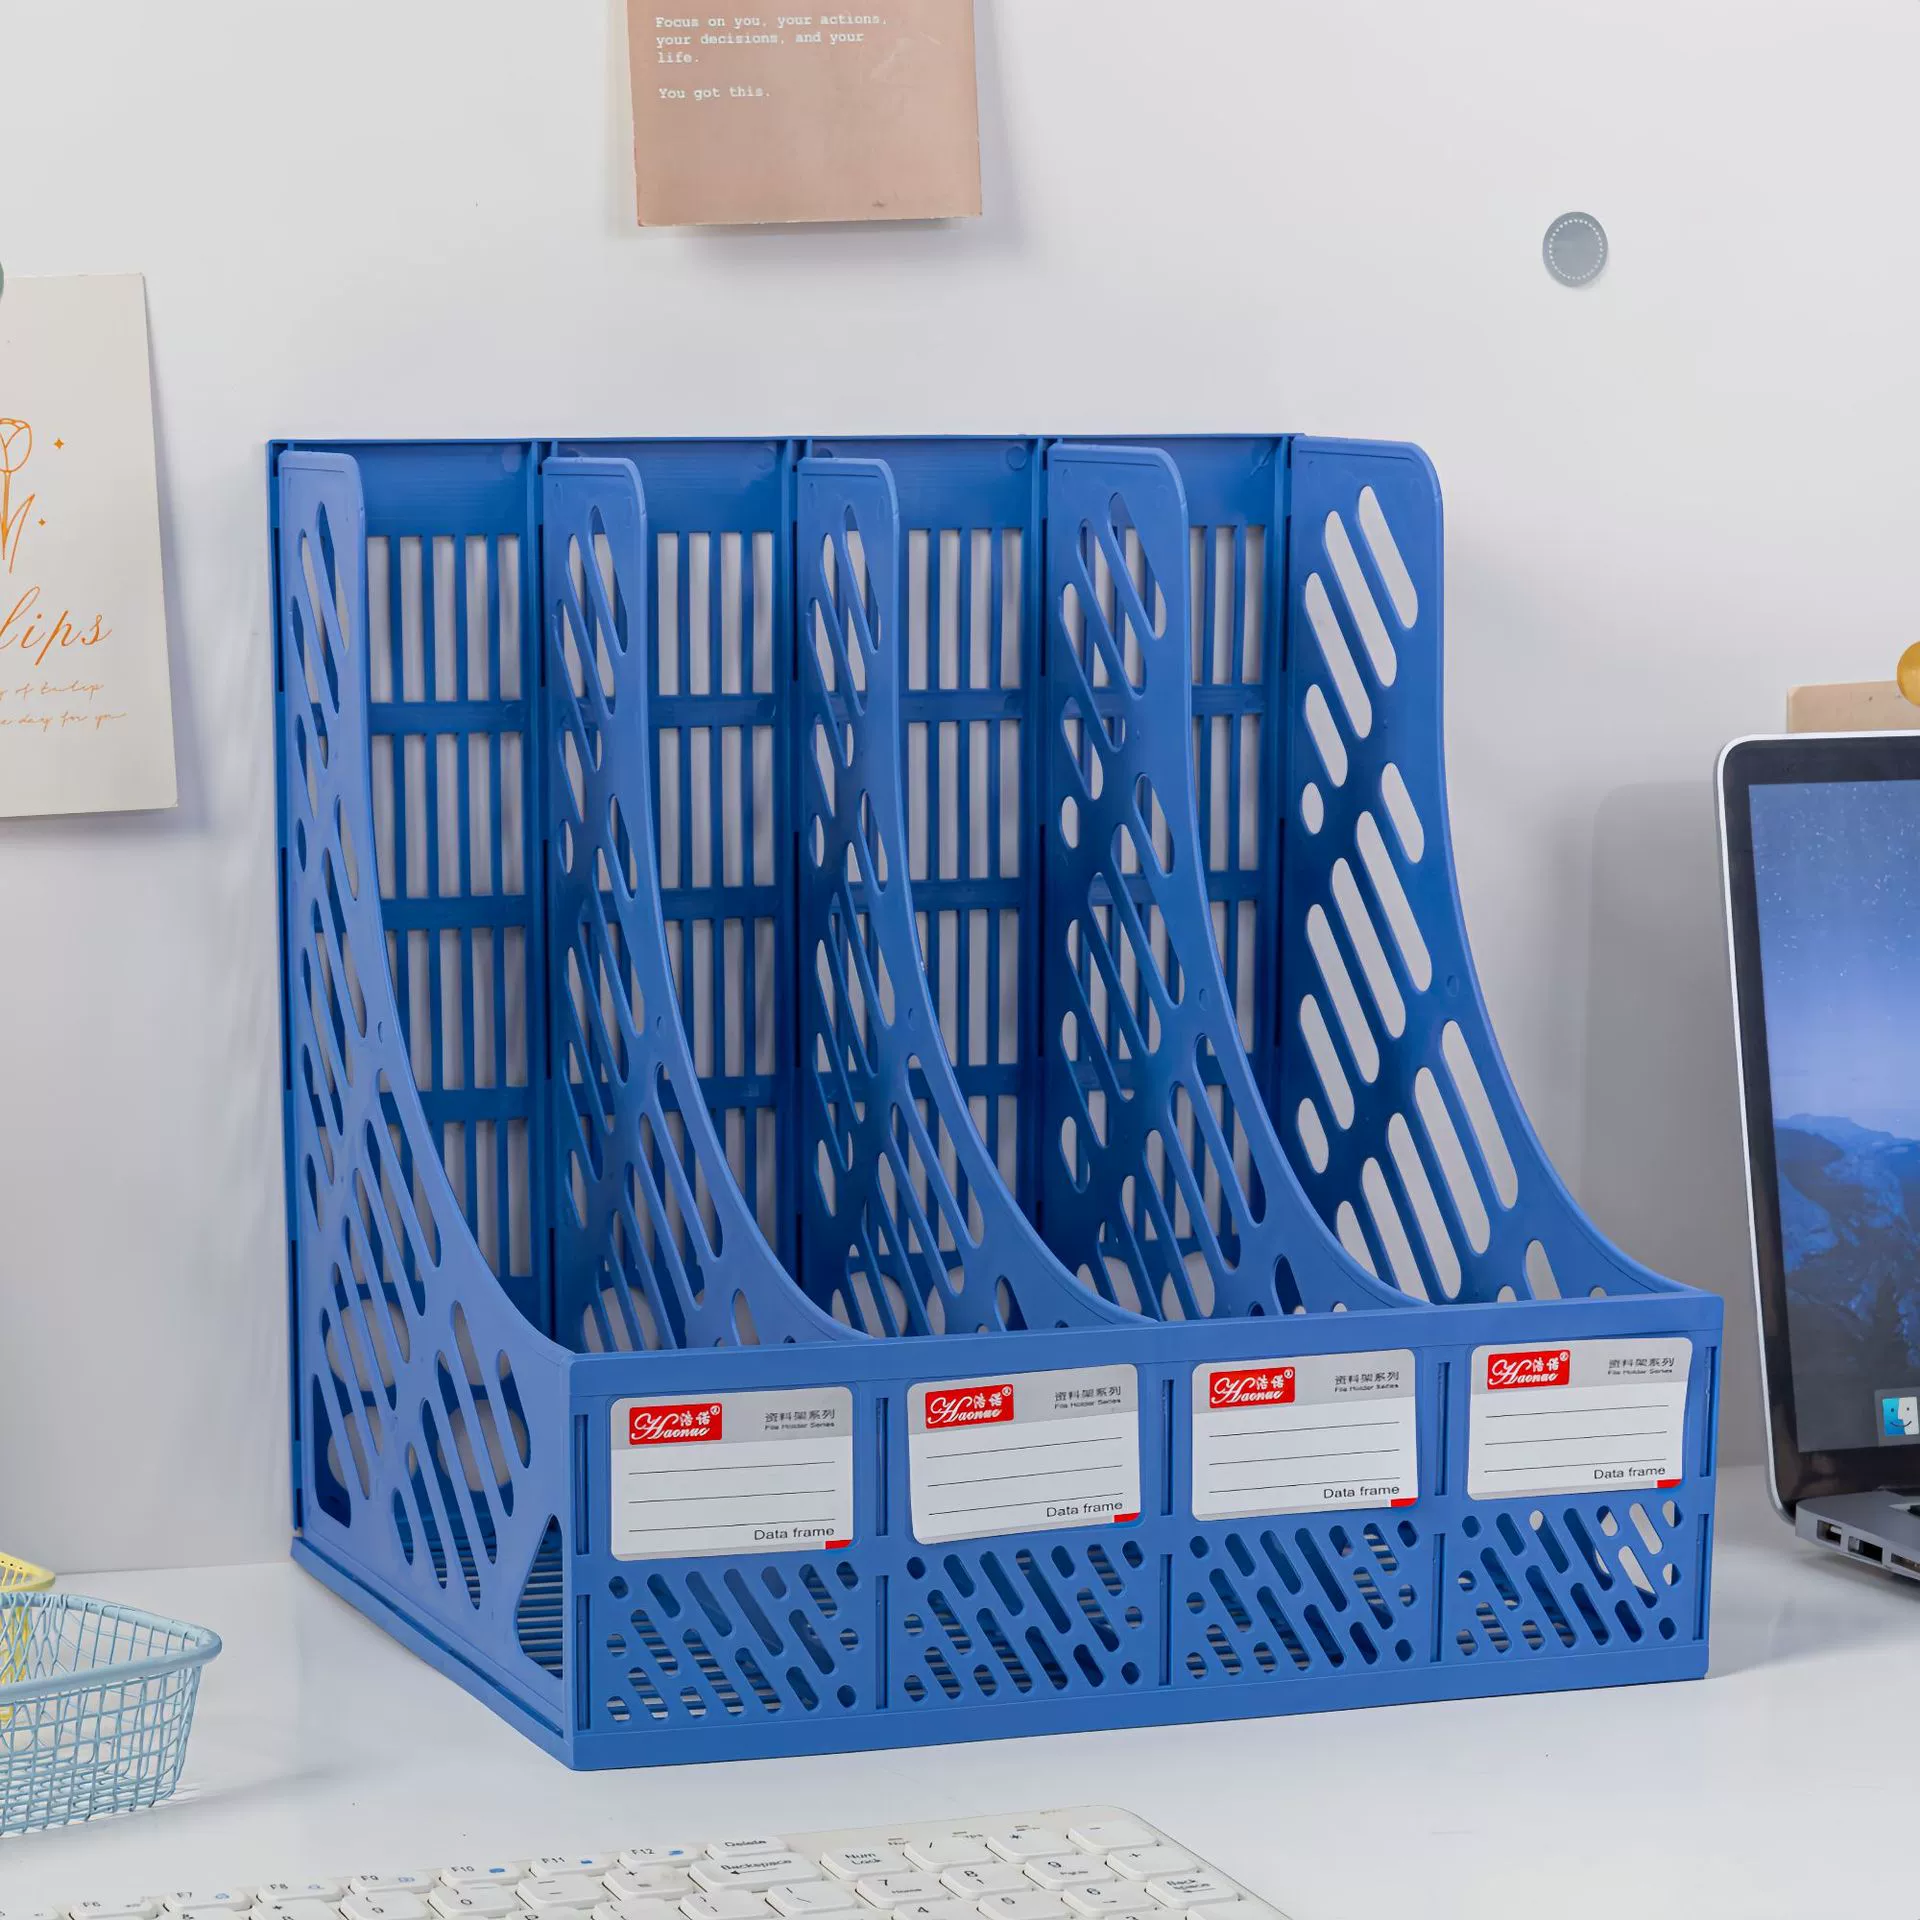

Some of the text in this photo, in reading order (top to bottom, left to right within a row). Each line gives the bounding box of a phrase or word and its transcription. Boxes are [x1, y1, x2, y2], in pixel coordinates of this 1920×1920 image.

[655, 17, 700, 28] Focus
[708, 17, 725, 28] on
[777, 15, 813, 28] your
[656, 35, 692, 48] your
[795, 32, 822, 44] and
[830, 32, 865, 45] your
[657, 52, 700, 64] life.
[659, 85, 771, 101] You got this.
[1594, 1466, 1666, 1480] Data frame
[1323, 1484, 1400, 1499] Data frame
[1046, 1502, 1123, 1518] Data frame
[754, 1526, 835, 1541] Data frame
